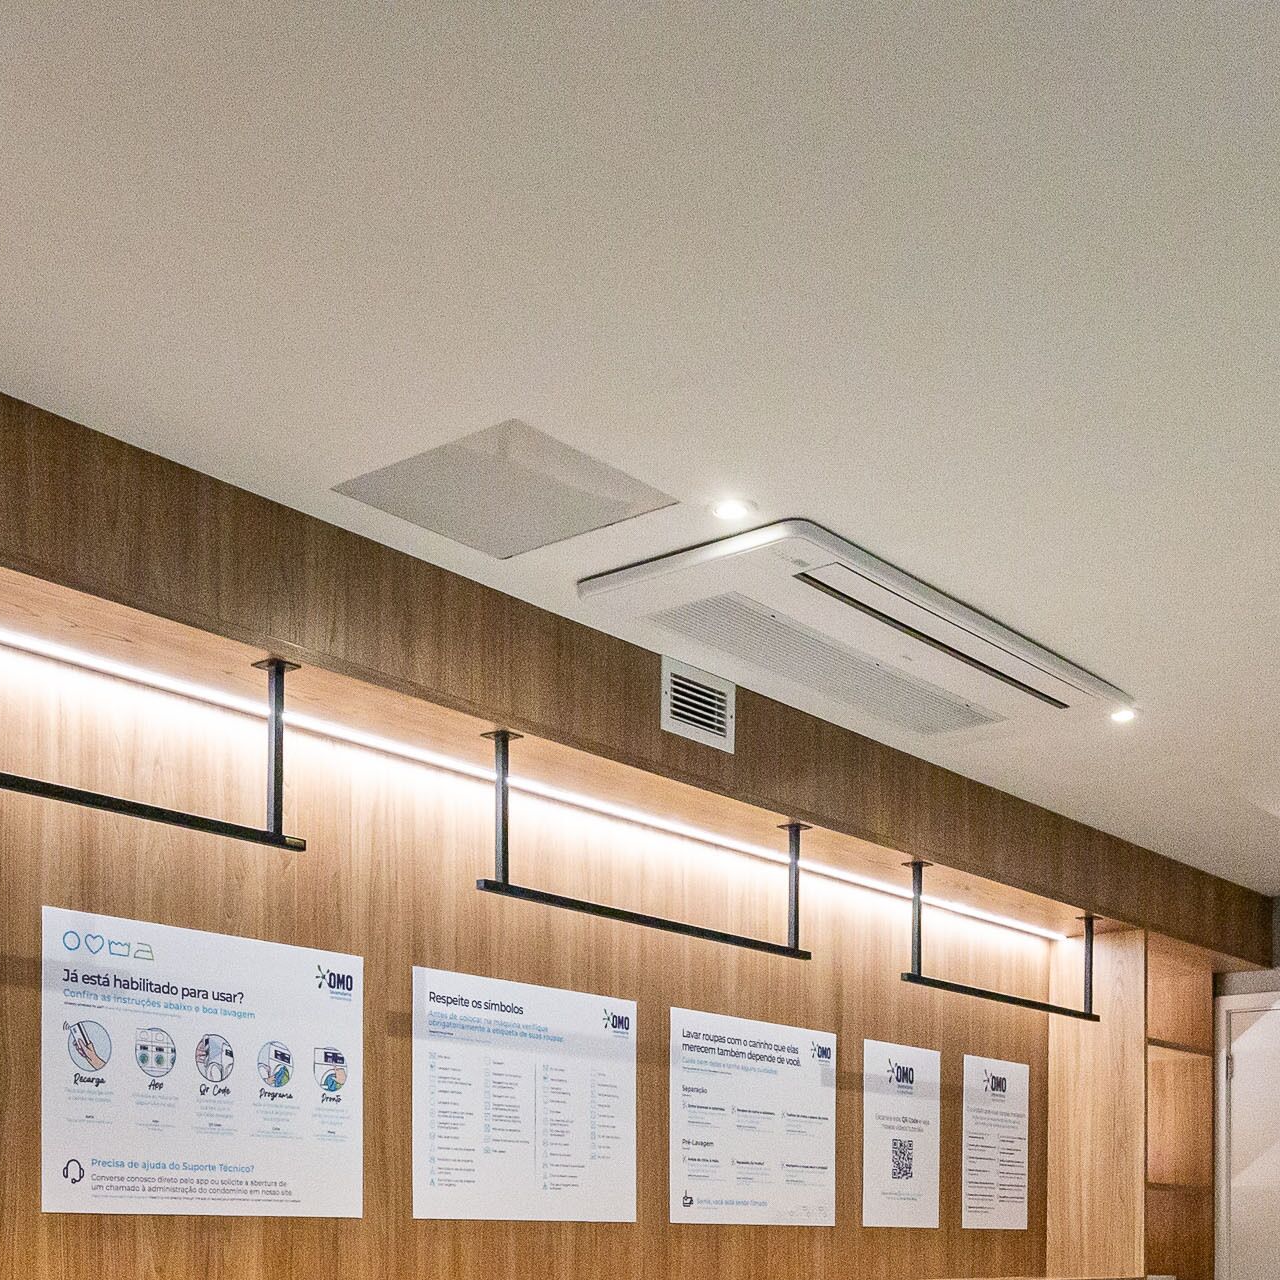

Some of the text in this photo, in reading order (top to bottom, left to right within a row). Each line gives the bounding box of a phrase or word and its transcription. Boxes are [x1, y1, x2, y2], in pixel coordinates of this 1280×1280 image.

[62, 969, 244, 1004] Já está habilitado para usar?
[328, 971, 353, 992] OMO
[63, 988, 100, 1001] Confira
[101, 993, 111, 1002] as
[112, 994, 161, 1009] instruções
[163, 1000, 192, 1012] abaixo
[202, 1004, 218, 1015] boa
[219, 1007, 256, 1020] lavagem
[429, 991, 524, 1015] Respeite os símbolos
[611, 1014, 630, 1031] OMO
[682, 1028, 799, 1055] Lavar roupas com o carinho que elas
[682, 1043, 716, 1055] merecem
[717, 1047, 747, 1060] também
[747, 1050, 776, 1064] depende
[776, 1055, 785, 1065] de
[818, 1045, 832, 1060] OMO
[73, 1072, 106, 1087] Recarga
[896, 1065, 914, 1085] OMO
[148, 1079, 164, 1091] App
[199, 1083, 232, 1097] Qr Code
[682, 1084, 708, 1094] Separação
[991, 1075, 1007, 1093] OMO
[259, 1087, 294, 1101] Programa
[321, 1092, 342, 1104] Pronto
[91, 1158, 255, 1174] Precisa de ajuda do Suporte Técnico?
[91, 1173, 125, 1183] Converse
[127, 1175, 156, 1183] conosco
[157, 1175, 178, 1184] direto
[179, 1176, 194, 1185] pelo
[196, 1178, 209, 1186] app
[105, 1183, 140, 1192] chamado
[147, 1185, 197, 1195] administração
[199, 1186, 207, 1194] do
[208, 1186, 248, 1195] condomínio
